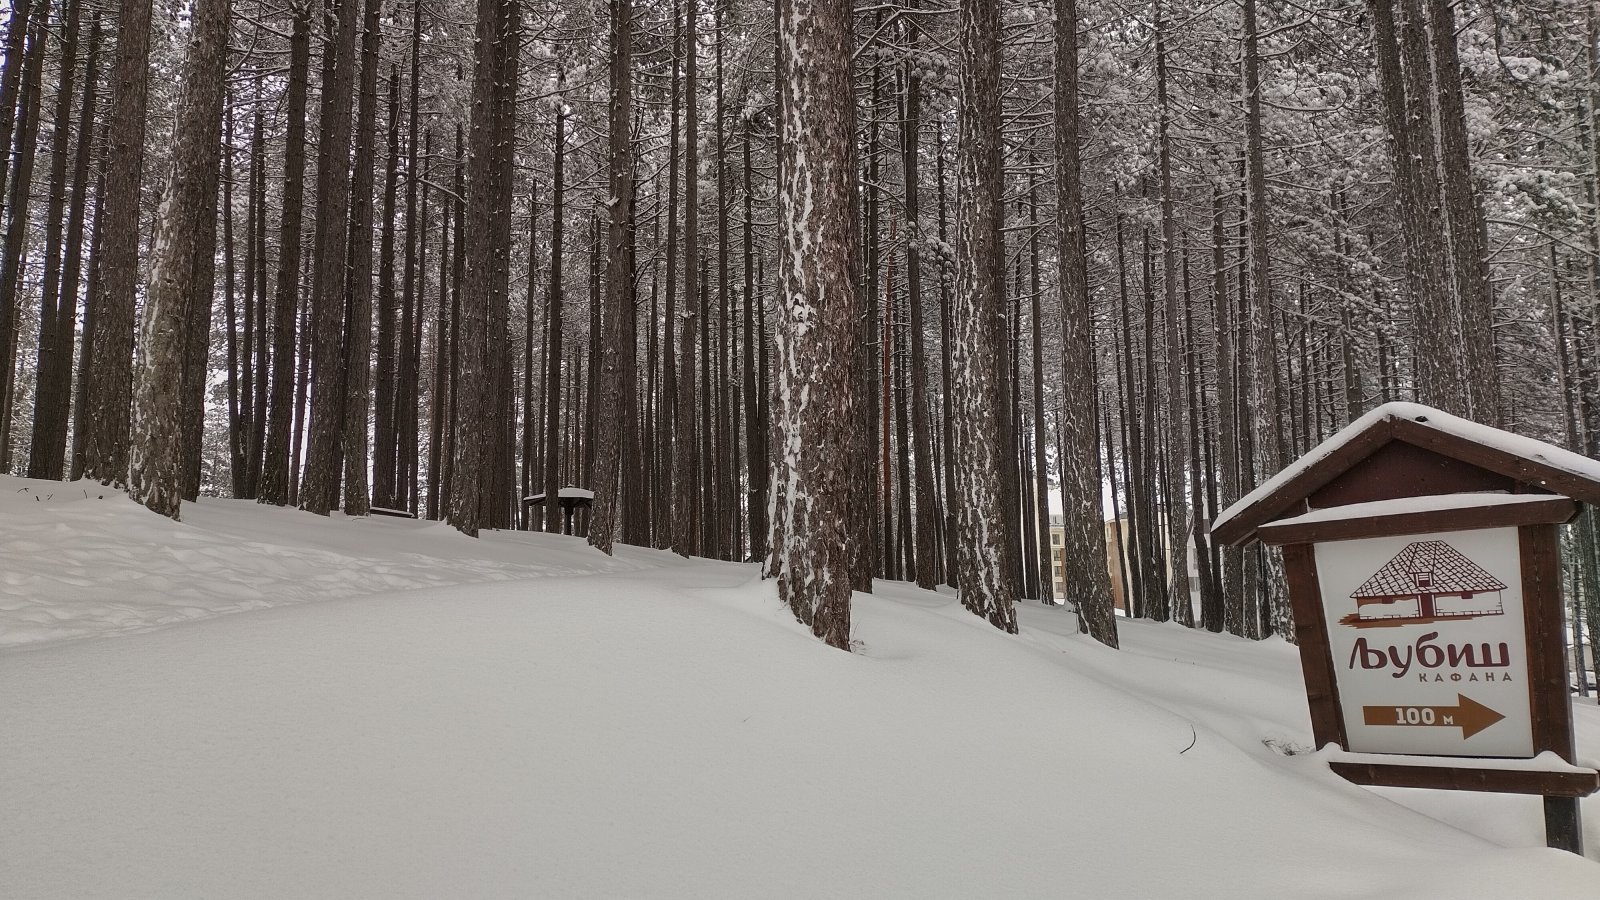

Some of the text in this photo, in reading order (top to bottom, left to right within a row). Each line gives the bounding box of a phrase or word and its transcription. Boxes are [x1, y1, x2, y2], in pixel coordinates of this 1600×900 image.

[1349, 631, 1510, 678] Љубиш
[1418, 672, 1512, 682] КАФАНА
[1395, 707, 1435, 725] 100
